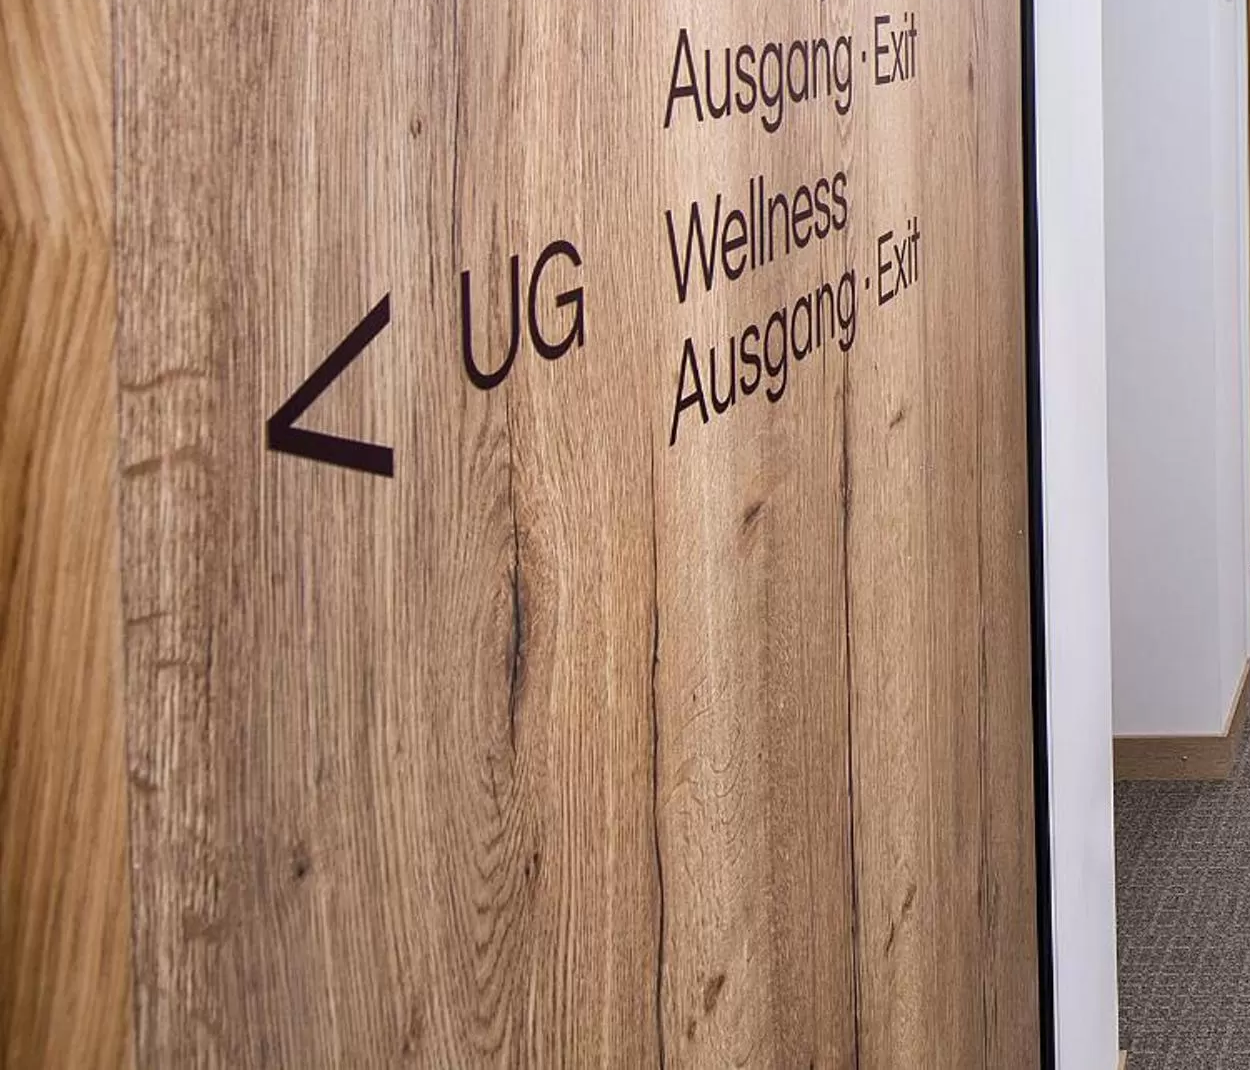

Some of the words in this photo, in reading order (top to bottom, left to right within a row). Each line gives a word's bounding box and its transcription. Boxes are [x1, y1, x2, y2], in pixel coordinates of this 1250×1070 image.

[663, 28, 852, 133] Ausgang
[874, 12, 918, 86] Exit
[460, 240, 584, 390] UG
[665, 171, 848, 303] Wellness
[669, 267, 856, 446] Ausgang
[878, 217, 920, 306] Exit
